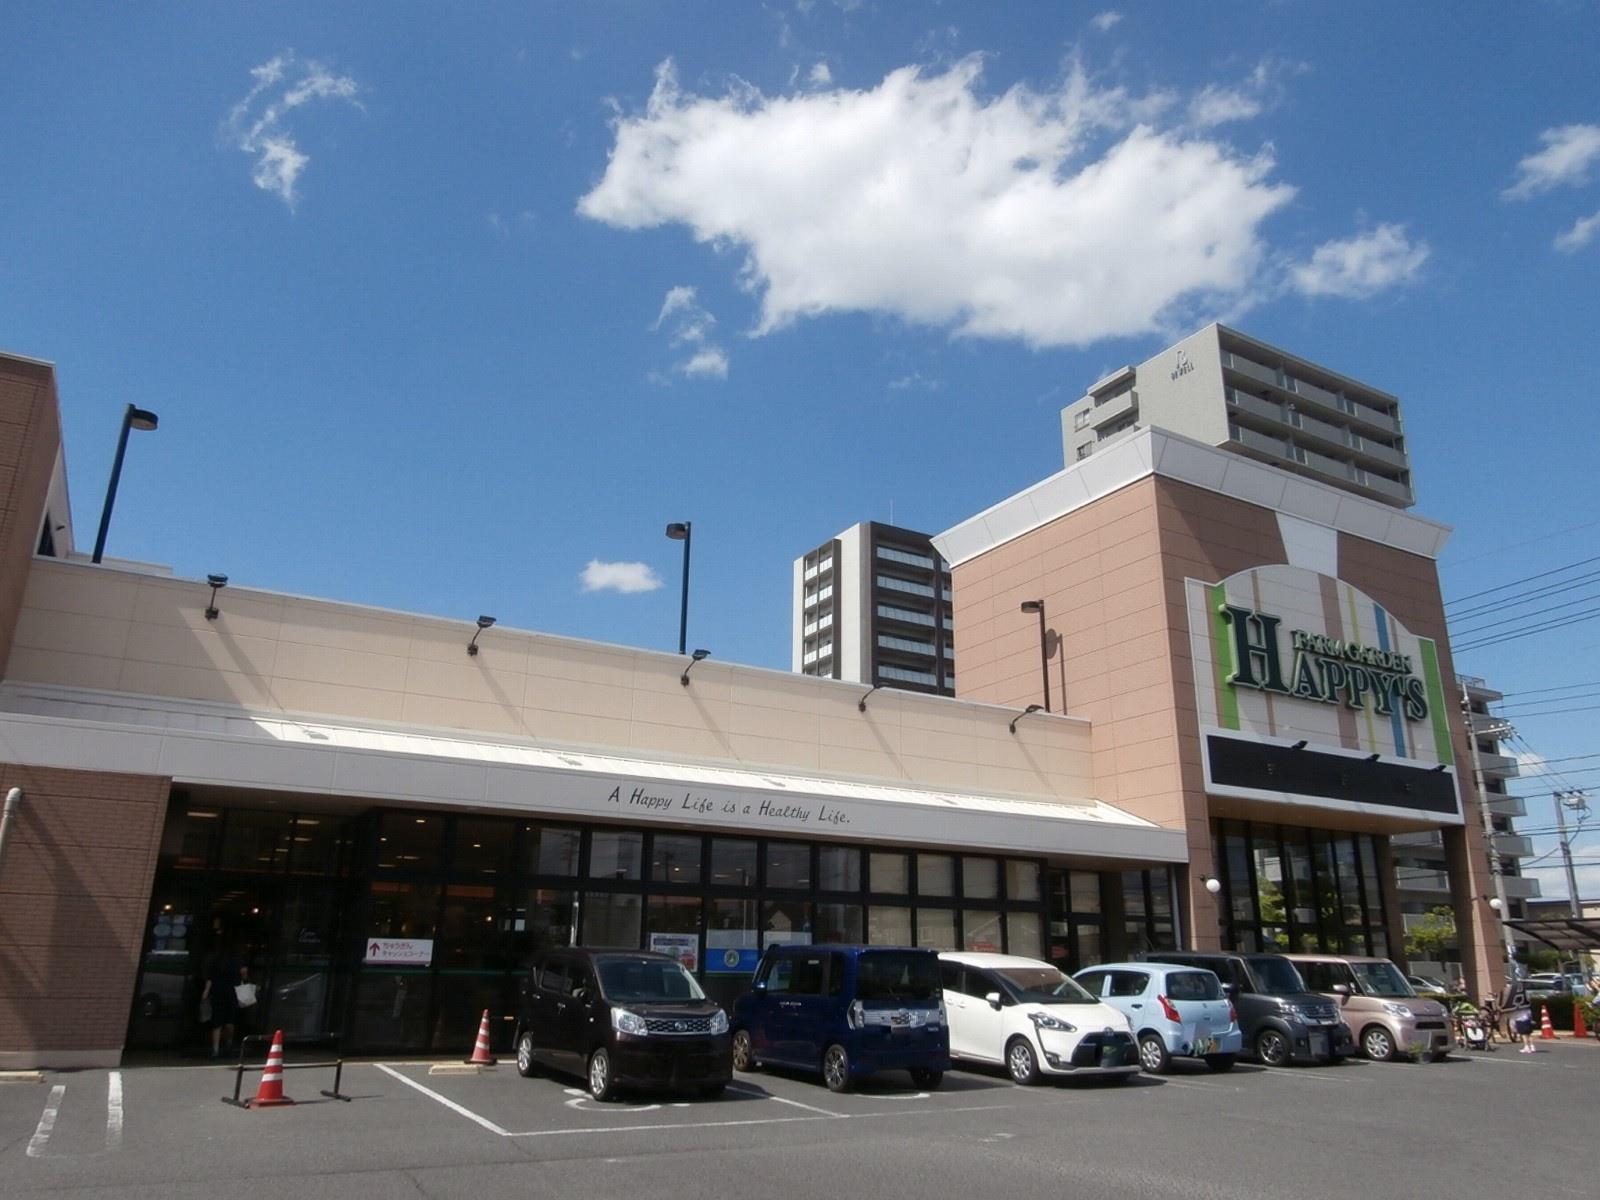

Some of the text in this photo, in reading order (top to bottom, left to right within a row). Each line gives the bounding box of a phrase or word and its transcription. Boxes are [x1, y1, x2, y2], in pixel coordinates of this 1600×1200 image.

[1218, 603, 1428, 721] HAPPY'S
[1290, 628, 1413, 674] FARM GARDEN
[608, 786, 851, 825] A Happy Life is a Healthy Life.
